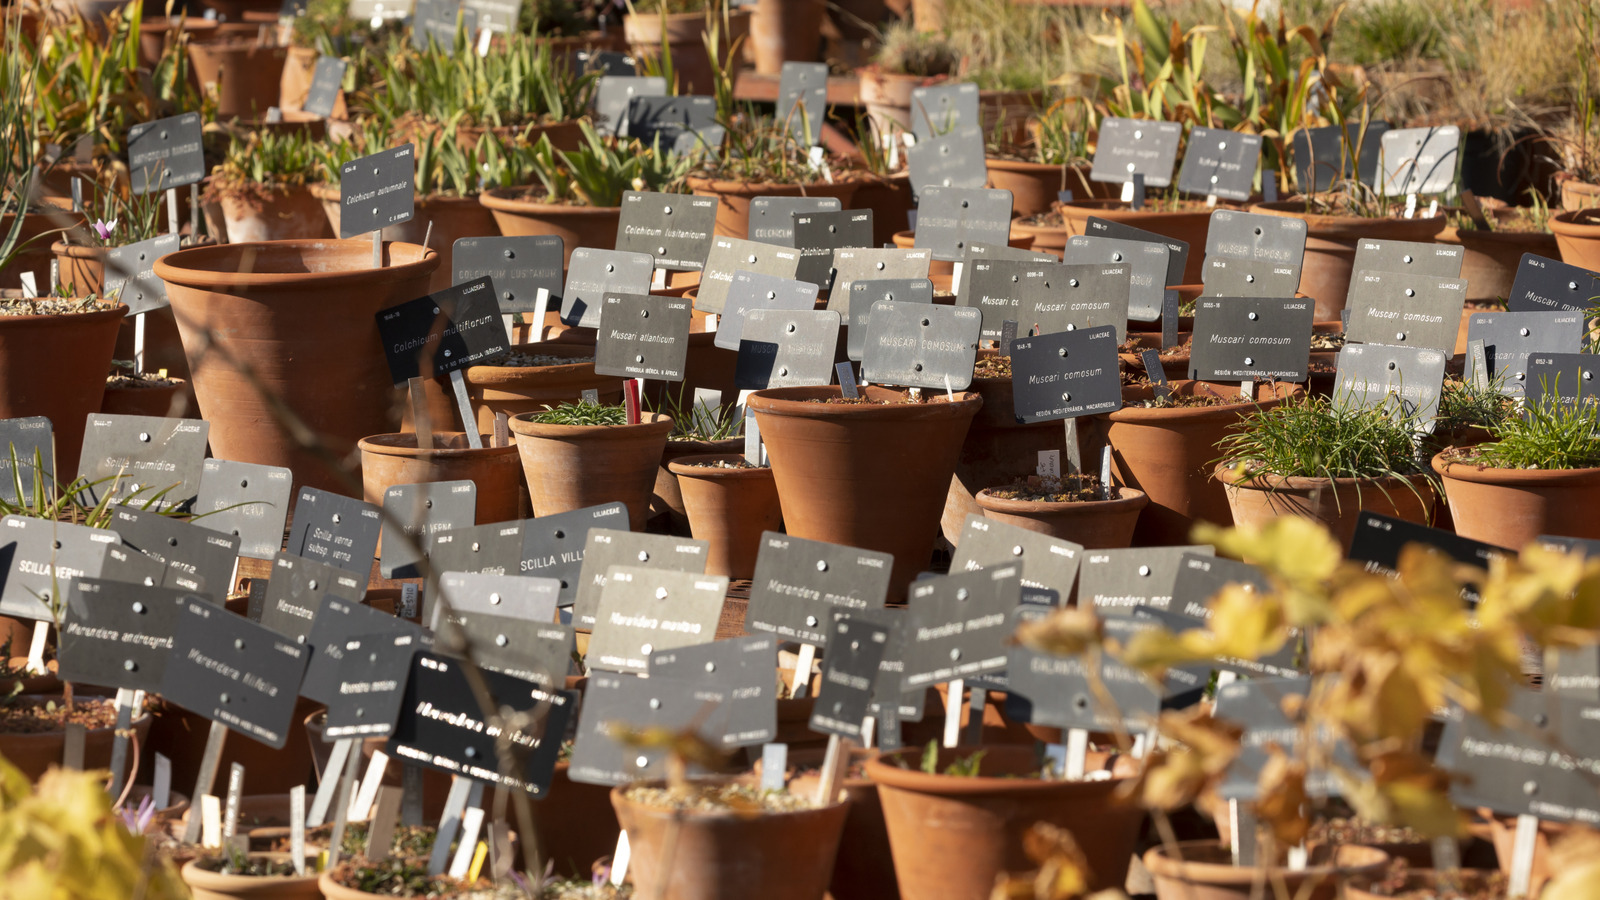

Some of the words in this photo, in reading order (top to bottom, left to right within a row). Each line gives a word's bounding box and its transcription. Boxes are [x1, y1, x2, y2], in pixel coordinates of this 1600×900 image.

[346, 190, 376, 206] Colchicum
[378, 179, 408, 196] autumnale
[625, 223, 662, 236] Colchicum
[665, 228, 707, 241] lusitanicum
[1253, 247, 1292, 261] COMOSUM
[458, 269, 506, 284] COLCHICUM
[1102, 269, 1124, 277] LILIACEAE
[981, 295, 1010, 307] Muscari
[1035, 302, 1068, 313] Muscari
[1071, 300, 1111, 312] comosum
[1524, 290, 1560, 308] Muscari
[1367, 307, 1401, 319] Muscari
[1403, 313, 1443, 324] comosum
[393, 332, 438, 355] Colchicum
[443, 313, 493, 339] multiflorum
[610, 329, 638, 343] Muscari
[639, 334, 676, 346] atlanticum
[1088, 331, 1110, 341] LILIACEAE
[1209, 333, 1246, 345] Muscari
[1249, 334, 1292, 345] comosum
[879, 335, 918, 348] MUSCARI
[921, 339, 966, 353] COMOSUM
[1028, 374, 1061, 386] Muscari
[1063, 367, 1103, 381] comosum
[1344, 380, 1381, 394] MUSCARI
[104, 456, 130, 469] Scilla
[593, 506, 621, 519] LILIACEAE
[313, 526, 333, 542] Scilla
[334, 535, 354, 548] verna
[332, 550, 353, 563] verna
[520, 551, 557, 572] SCILLA
[19, 558, 52, 577] SCILLA
[767, 578, 821, 602] Merendera
[824, 592, 869, 611] montana
[1092, 594, 1147, 608] Merendera
[186, 647, 241, 681] Merendera
